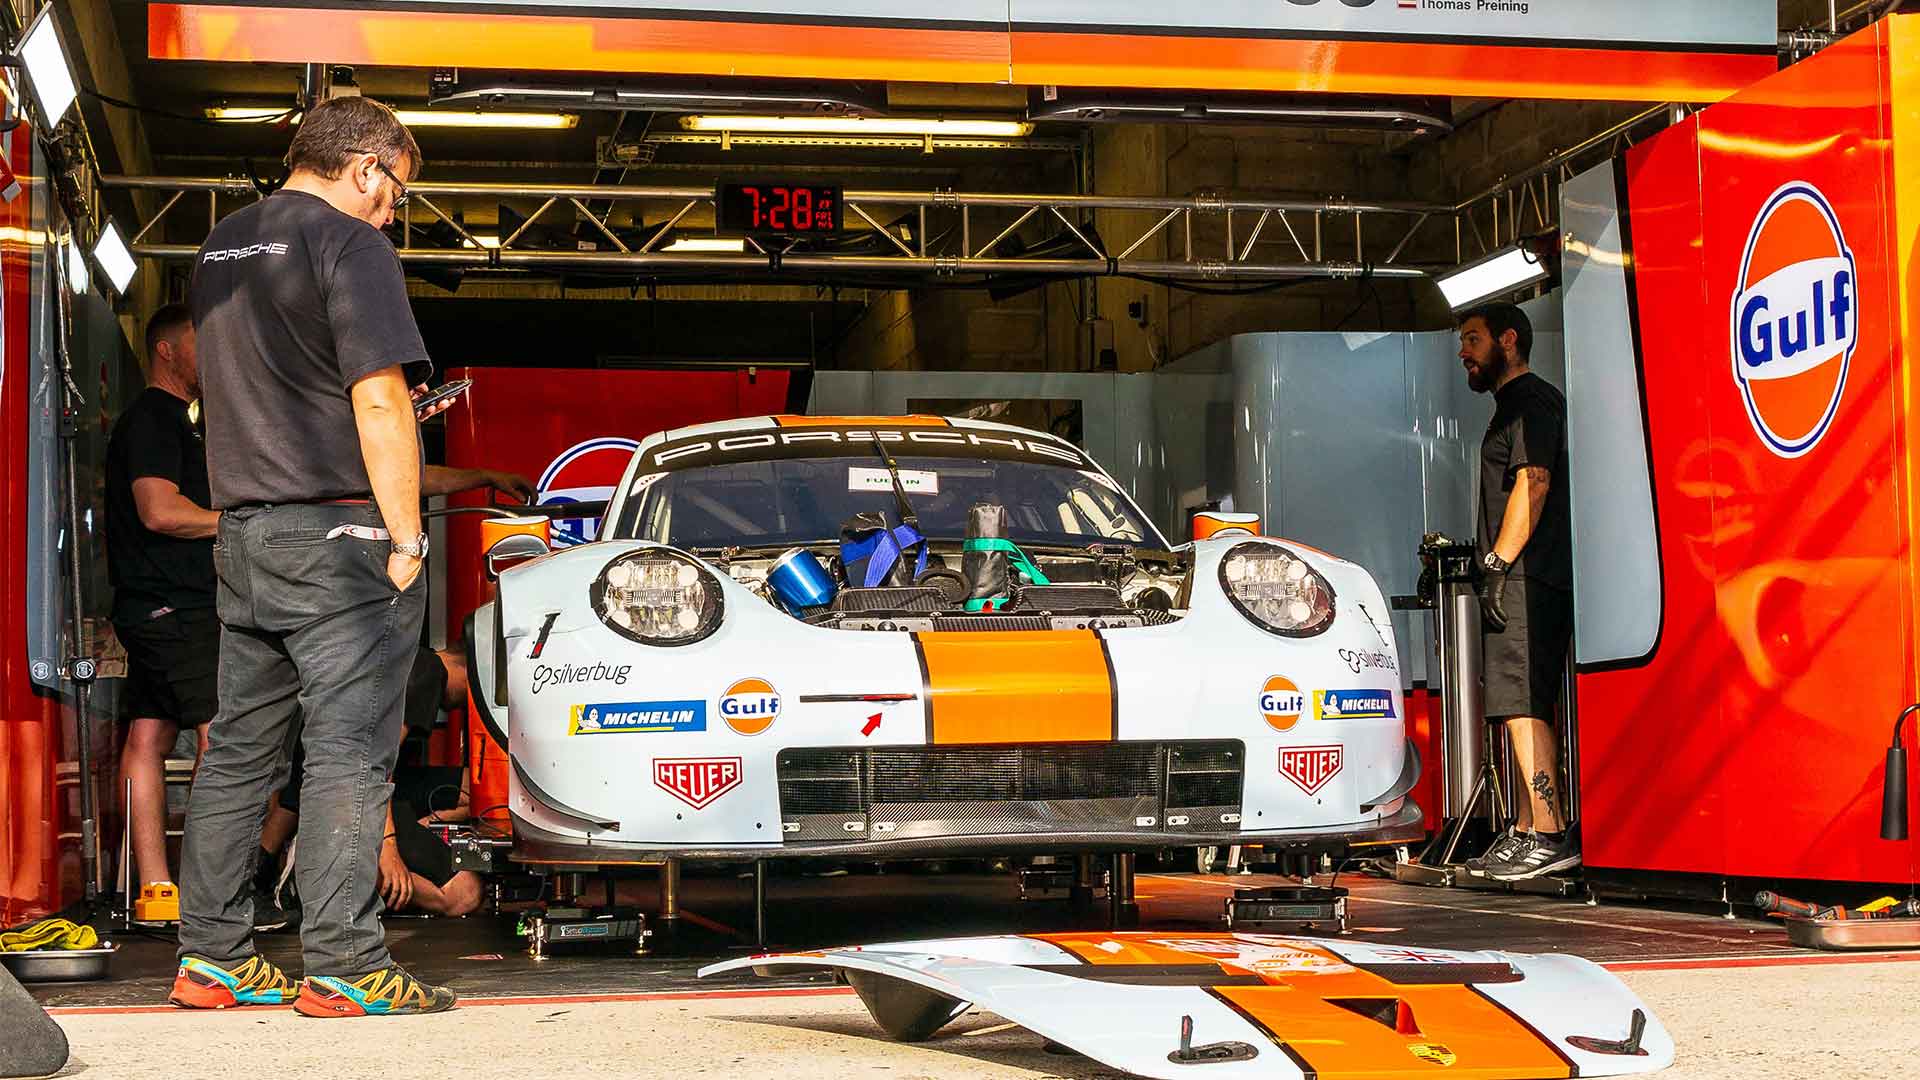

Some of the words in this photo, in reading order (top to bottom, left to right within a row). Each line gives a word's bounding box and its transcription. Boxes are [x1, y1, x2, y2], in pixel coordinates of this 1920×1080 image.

[1421, 0, 1471, 10] Thomas
[1477, 0, 1529, 14] Preining
[742, 187, 813, 229] 7:28
[203, 242, 289, 264] PORSCHE
[1740, 270, 1850, 368] Gulf
[654, 431, 1083, 467] PORSCHE
[550, 661, 632, 685] silverbug
[721, 698, 780, 716] Gulf
[1261, 694, 1304, 712] Gulf
[1340, 698, 1390, 711] MICHELIN
[602, 710, 696, 726] MICHELIN
[1284, 751, 1339, 788] HEUER
[660, 763, 736, 802] HEUER
